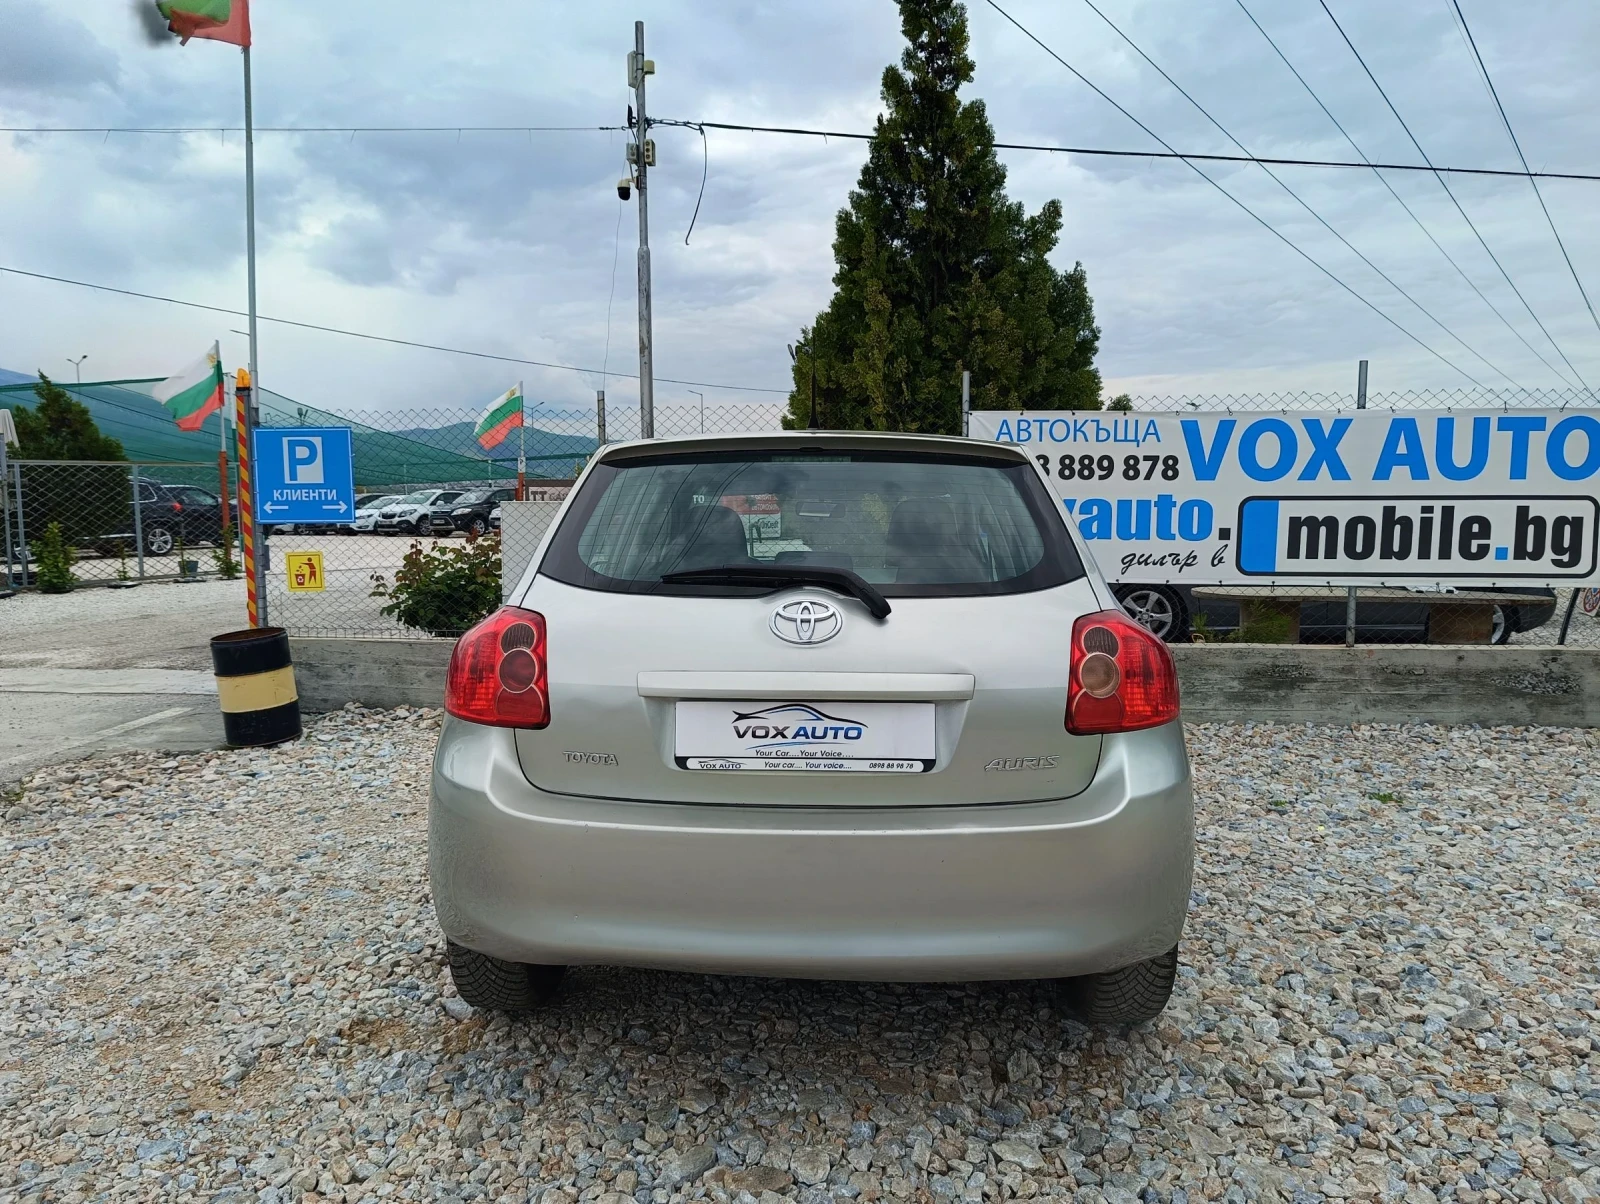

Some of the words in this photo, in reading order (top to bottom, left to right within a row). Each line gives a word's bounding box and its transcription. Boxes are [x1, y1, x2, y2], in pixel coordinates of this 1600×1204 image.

[995, 418, 1162, 447] АВТОКЪЩА
[287, 439, 318, 482] P
[1180, 417, 1354, 482] VOX
[1371, 415, 1600, 482] AUTO
[1057, 454, 1115, 481] 889
[1122, 454, 1180, 481] 878
[273, 489, 337, 501] КЛИЕНТИ
[1286, 505, 1584, 569] mobile.bg
[1120, 550, 1199, 575] дилър
[1210, 544, 1230, 568] в
[732, 725, 791, 739] VOX
[791, 726, 863, 740] AUTO
[562, 750, 619, 766] TOYOTA
[983, 755, 1061, 772] AURIS
